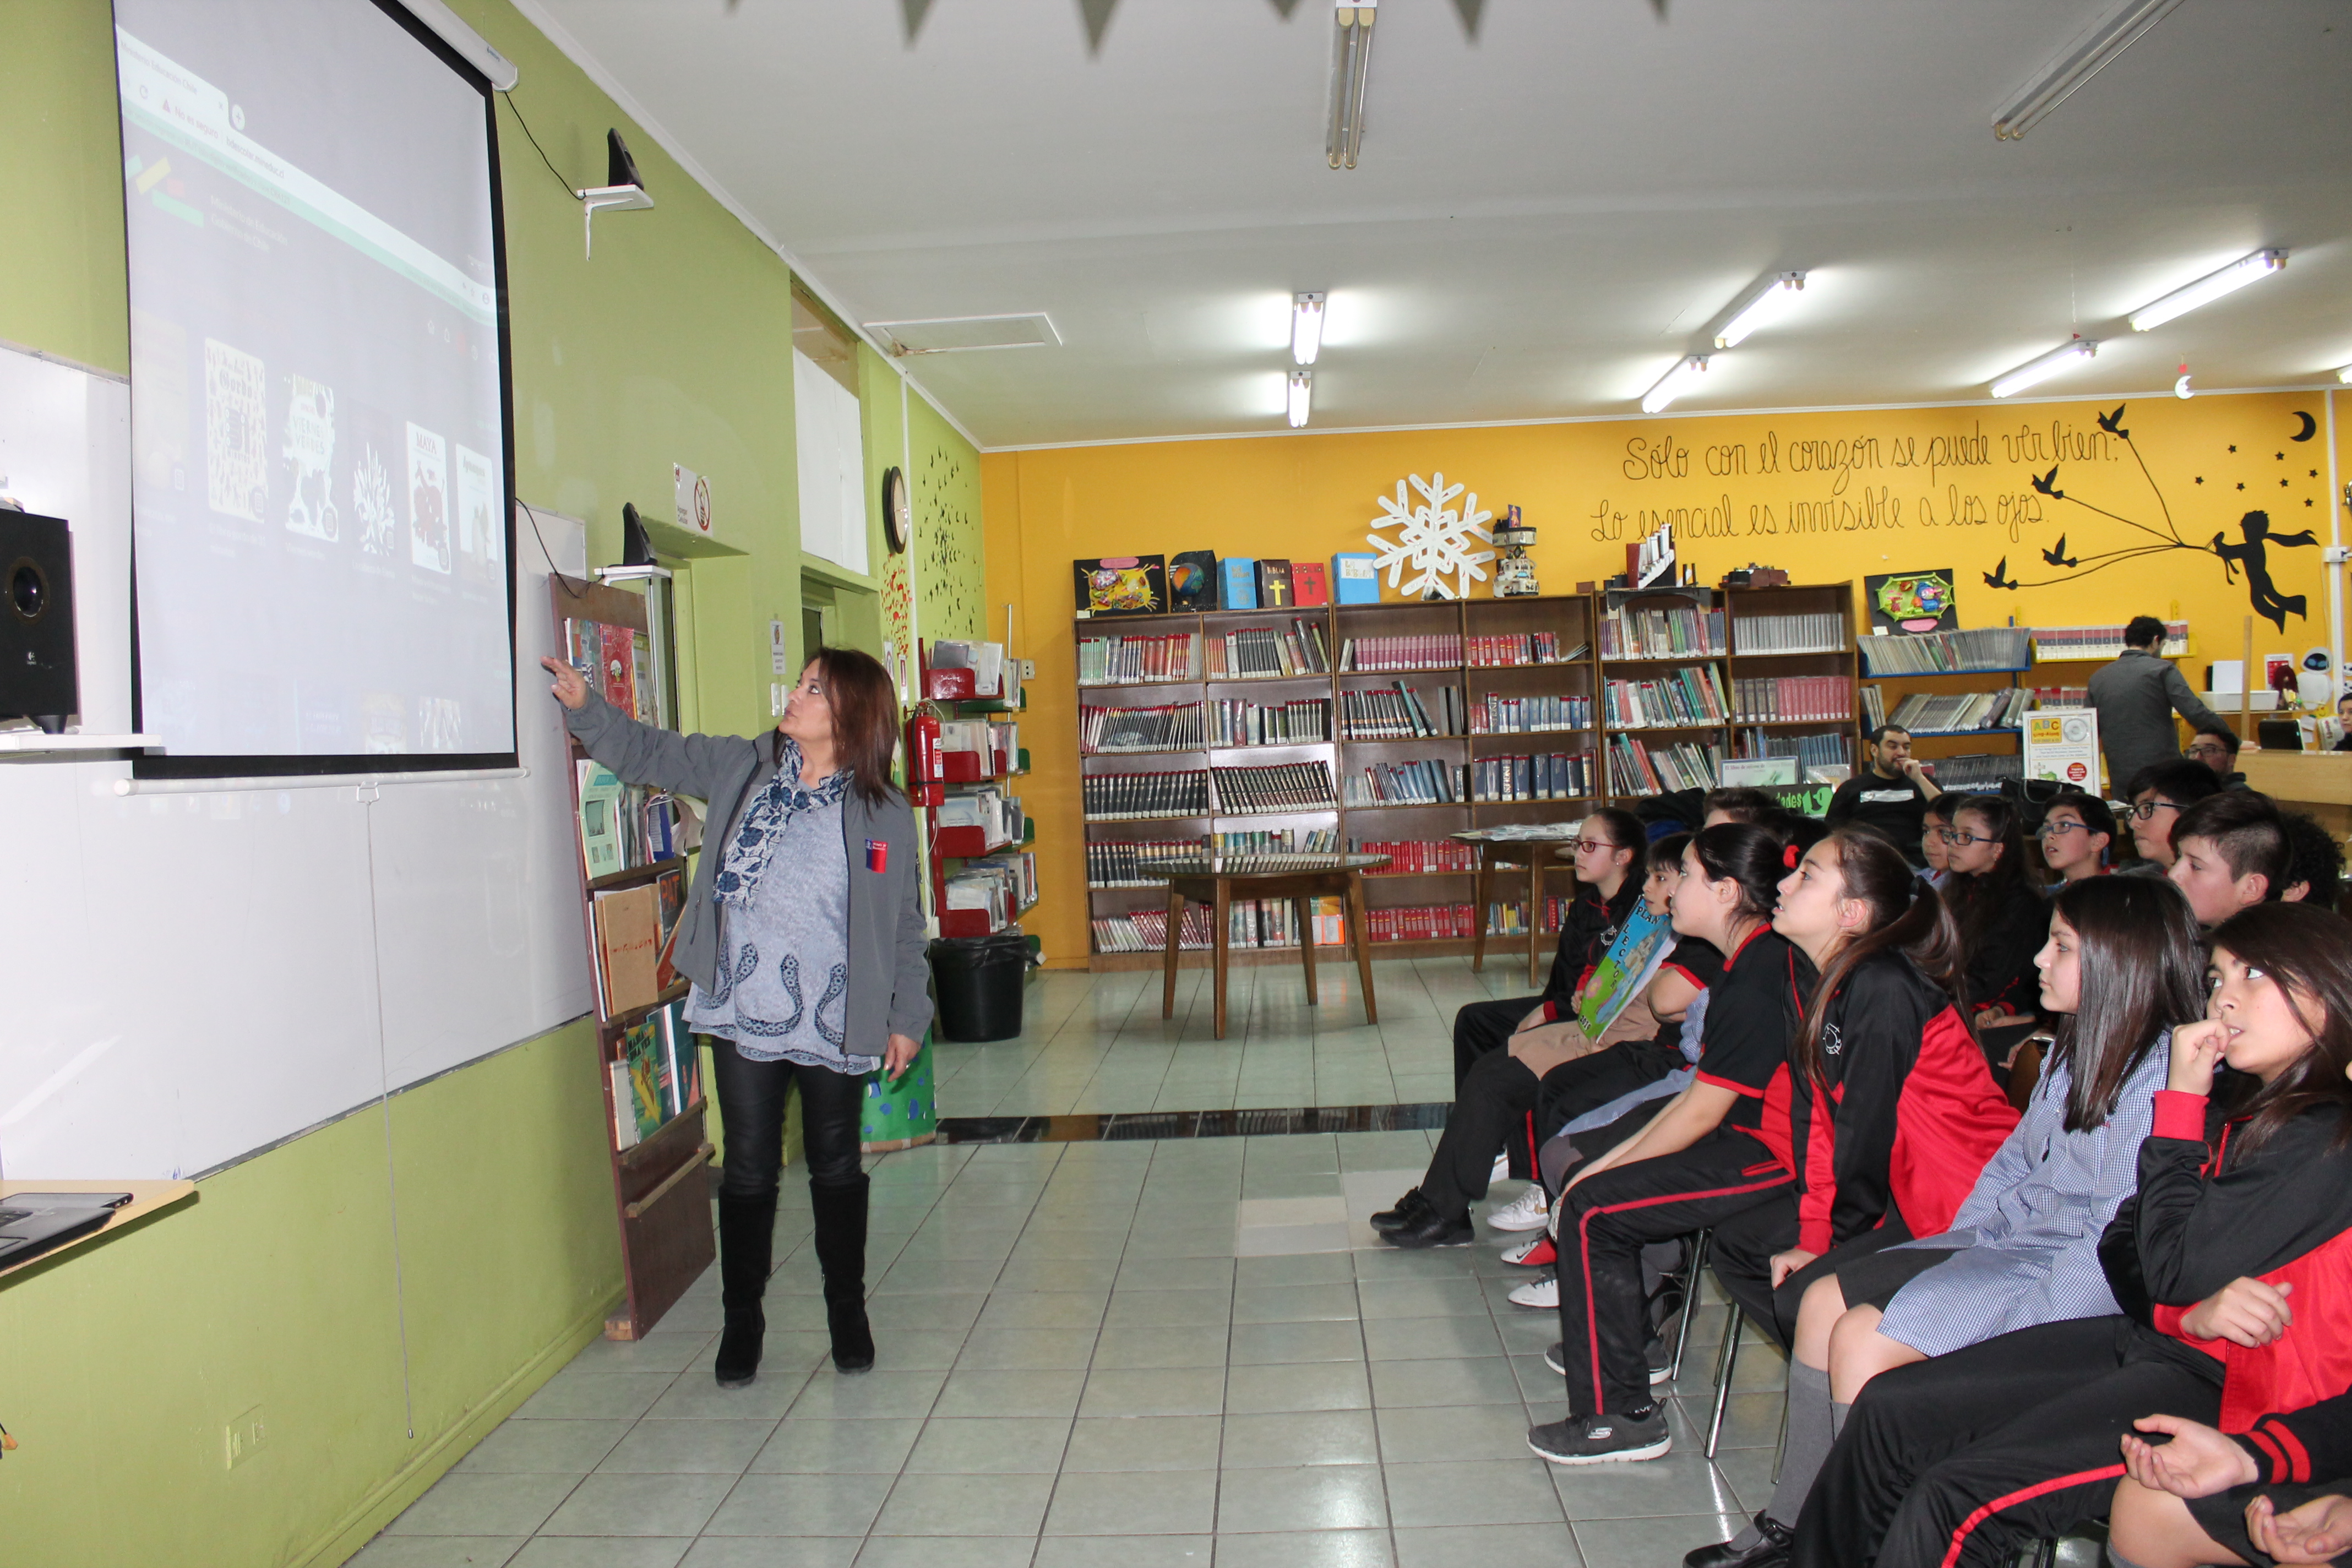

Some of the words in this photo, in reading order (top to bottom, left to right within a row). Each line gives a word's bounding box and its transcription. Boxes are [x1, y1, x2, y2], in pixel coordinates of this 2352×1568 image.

[175, 105, 185, 121] No
[187, 114, 195, 126] es
[196, 119, 219, 139] seguro
[416, 431, 438, 455] MAYA
[1623, 435, 1690, 481] Sólo
[1706, 444, 1749, 476] con
[1757, 431, 1782, 474] el
[1789, 433, 1884, 496] corazón
[1891, 437, 1920, 467] se
[1923, 420, 1992, 488] puede
[2002, 424, 2049, 463] ver
[1590, 499, 1629, 542] Lo
[1636, 494, 1740, 541] esencial
[1746, 504, 1779, 536] es
[1785, 486, 1905, 534] invisible
[1919, 497, 1939, 527] a
[1945, 484, 1988, 526] los
[2034, 720, 2060, 731] ABC
[1635, 906, 1661, 926] PLAN
[1579, 1014, 1592, 1032] 2019
